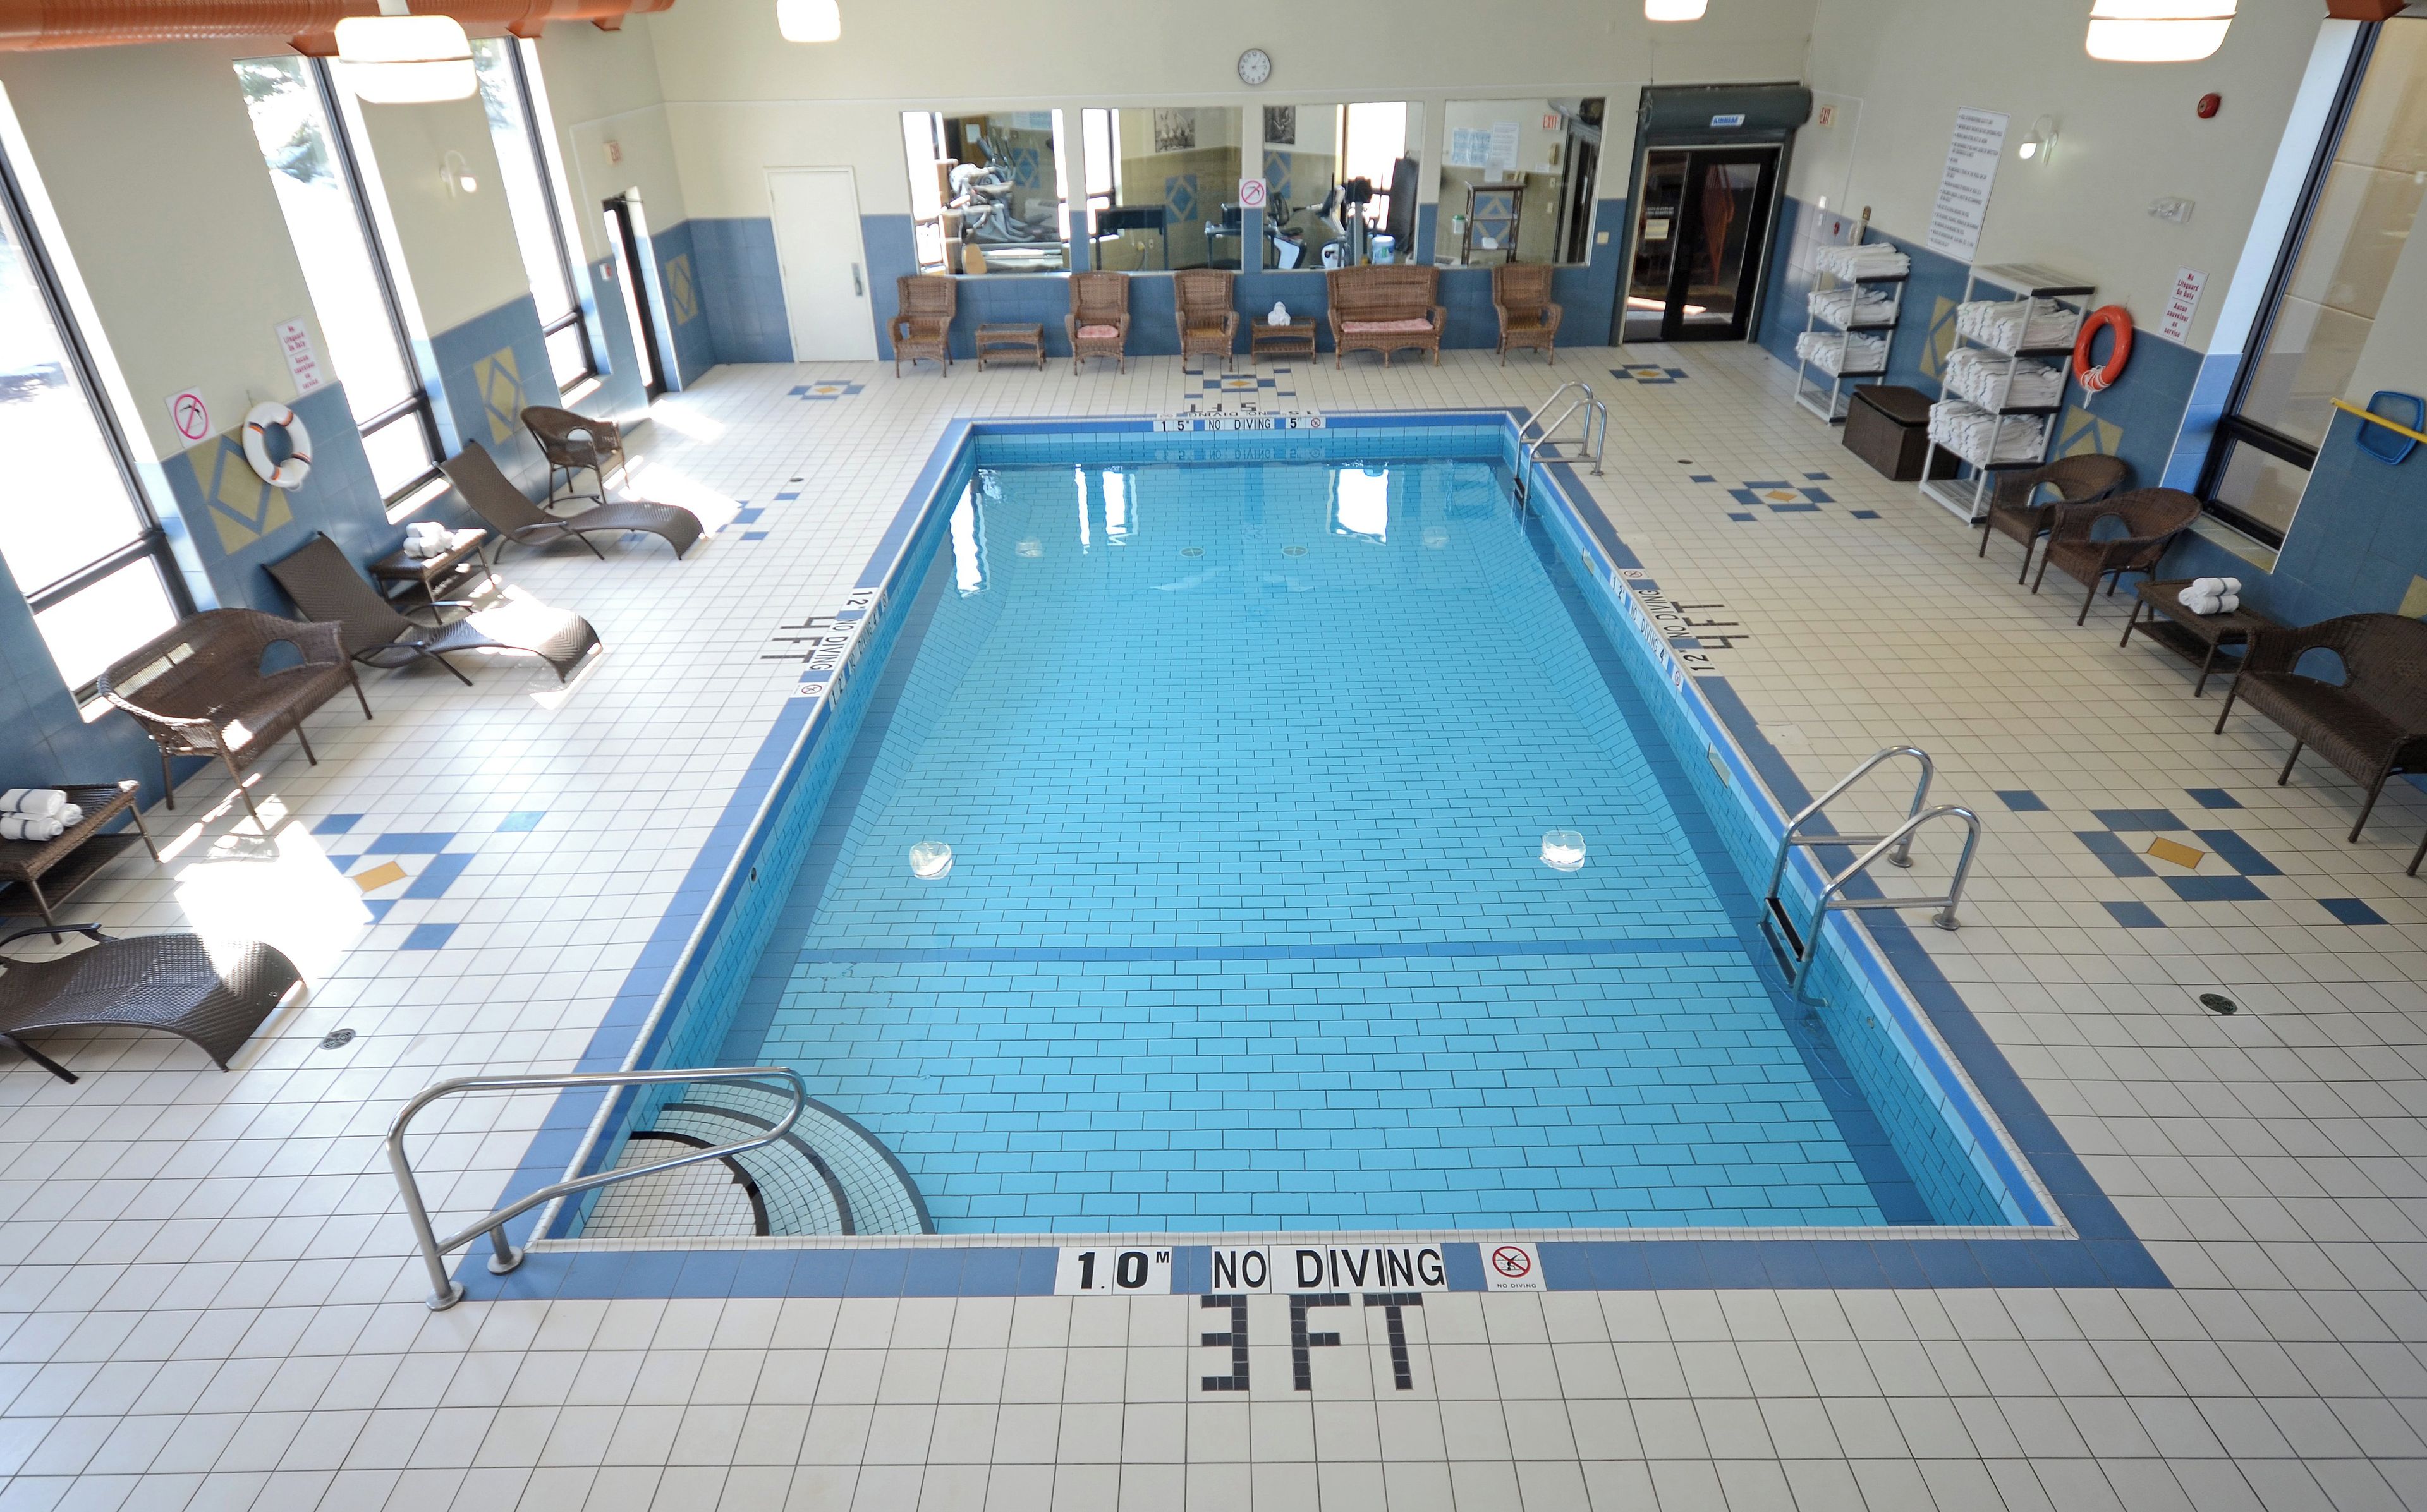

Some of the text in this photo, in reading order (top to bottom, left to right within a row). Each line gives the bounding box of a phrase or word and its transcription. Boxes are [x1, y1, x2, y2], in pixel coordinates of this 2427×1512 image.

[1543, 113, 1557, 130] EXIT
[2177, 279, 2199, 291] Lifeguard
[2184, 290, 2194, 300] Duty
[2174, 302, 2187, 312] Aucun
[2167, 310, 2189, 322] sauveteur
[2164, 327, 2180, 337] service
[1209, 420, 1220, 430] NO
[1234, 418, 1270, 430] DIVING
[1639, 590, 1679, 620] DIVING
[1670, 601, 1739, 627] FT
[832, 619, 858, 631] NO
[1664, 626, 1691, 638] NO
[760, 616, 837, 663] 4 FT
[810, 636, 848, 670] DIVING
[1214, 1250, 1267, 1288] NO
[1296, 1248, 1445, 1288] DIVING
[1201, 1293, 1423, 1391] 3 FT
